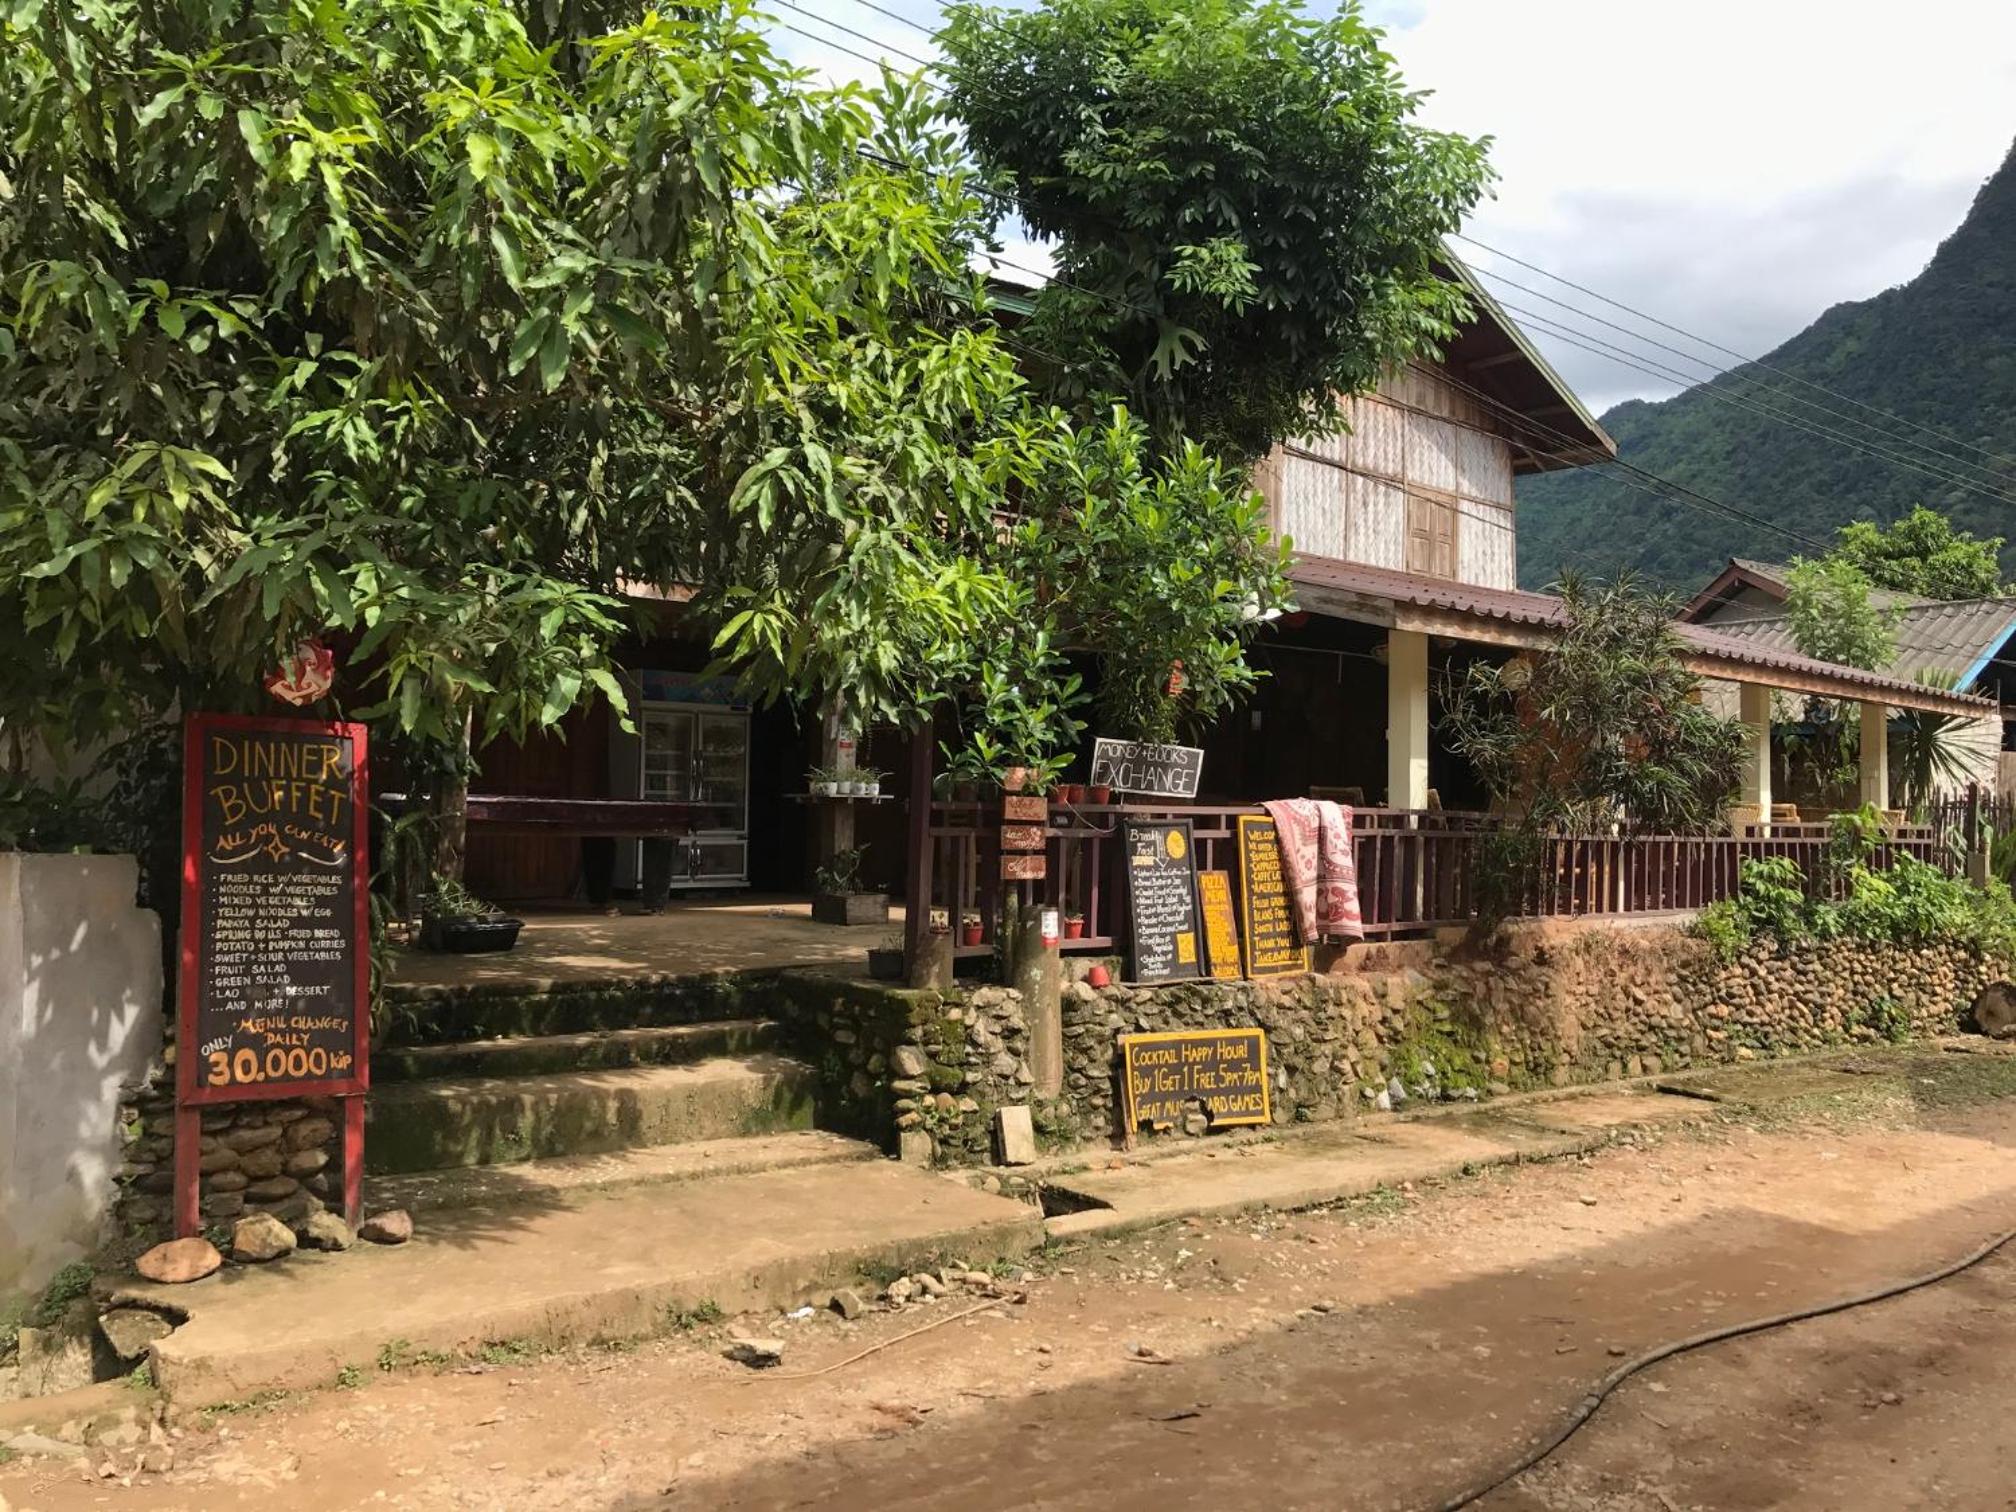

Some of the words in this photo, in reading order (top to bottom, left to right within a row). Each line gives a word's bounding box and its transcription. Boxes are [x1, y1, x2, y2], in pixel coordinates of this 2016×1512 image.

[212, 736, 343, 779] DINNER
[1098, 743, 1142, 759] MONEY
[1095, 759, 1195, 794] EXCHANGE
[209, 780, 347, 825] BUFFET
[216, 832, 247, 850] ALL
[249, 822, 276, 844] YOU
[284, 824, 311, 840] CAN
[220, 873, 250, 884] FRIED
[253, 873, 275, 883] RICE
[219, 885, 261, 895] NOODLES
[285, 885, 338, 896] VEGETABLES
[219, 895, 252, 905] MIXED
[255, 895, 316, 906] VEGETABLES
[218, 907, 256, 917] YELLOW
[259, 907, 298, 917] NOODLES
[216, 918, 251, 929] PAPAYA
[255, 918, 290, 928] SALAD
[215, 929, 251, 940] SPRING
[254, 929, 281, 939] ROLLS
[314, 928, 341, 939] BREAD
[216, 941, 255, 952] POTATO
[268, 940, 306, 951] PUMPKIN
[309, 938, 346, 949] CURRIES
[215, 953, 249, 963] SWEET
[257, 952, 284, 962] SOUR
[286, 951, 342, 961] VEGETABLES
[215, 965, 246, 975] FRUIT
[251, 964, 287, 974] SALAD
[215, 976, 251, 987] GREEN
[255, 974, 291, 985] SALAD
[216, 988, 240, 998] LAO
[285, 985, 331, 996] DESSERT
[254, 998, 289, 1011] MORE!
[237, 1016, 287, 1033] MENU
[291, 1015, 348, 1033] CHANGES
[201, 1034, 233, 1056] ONLY
[264, 1033, 310, 1046] DAILY
[207, 1047, 328, 1086] 30.000
